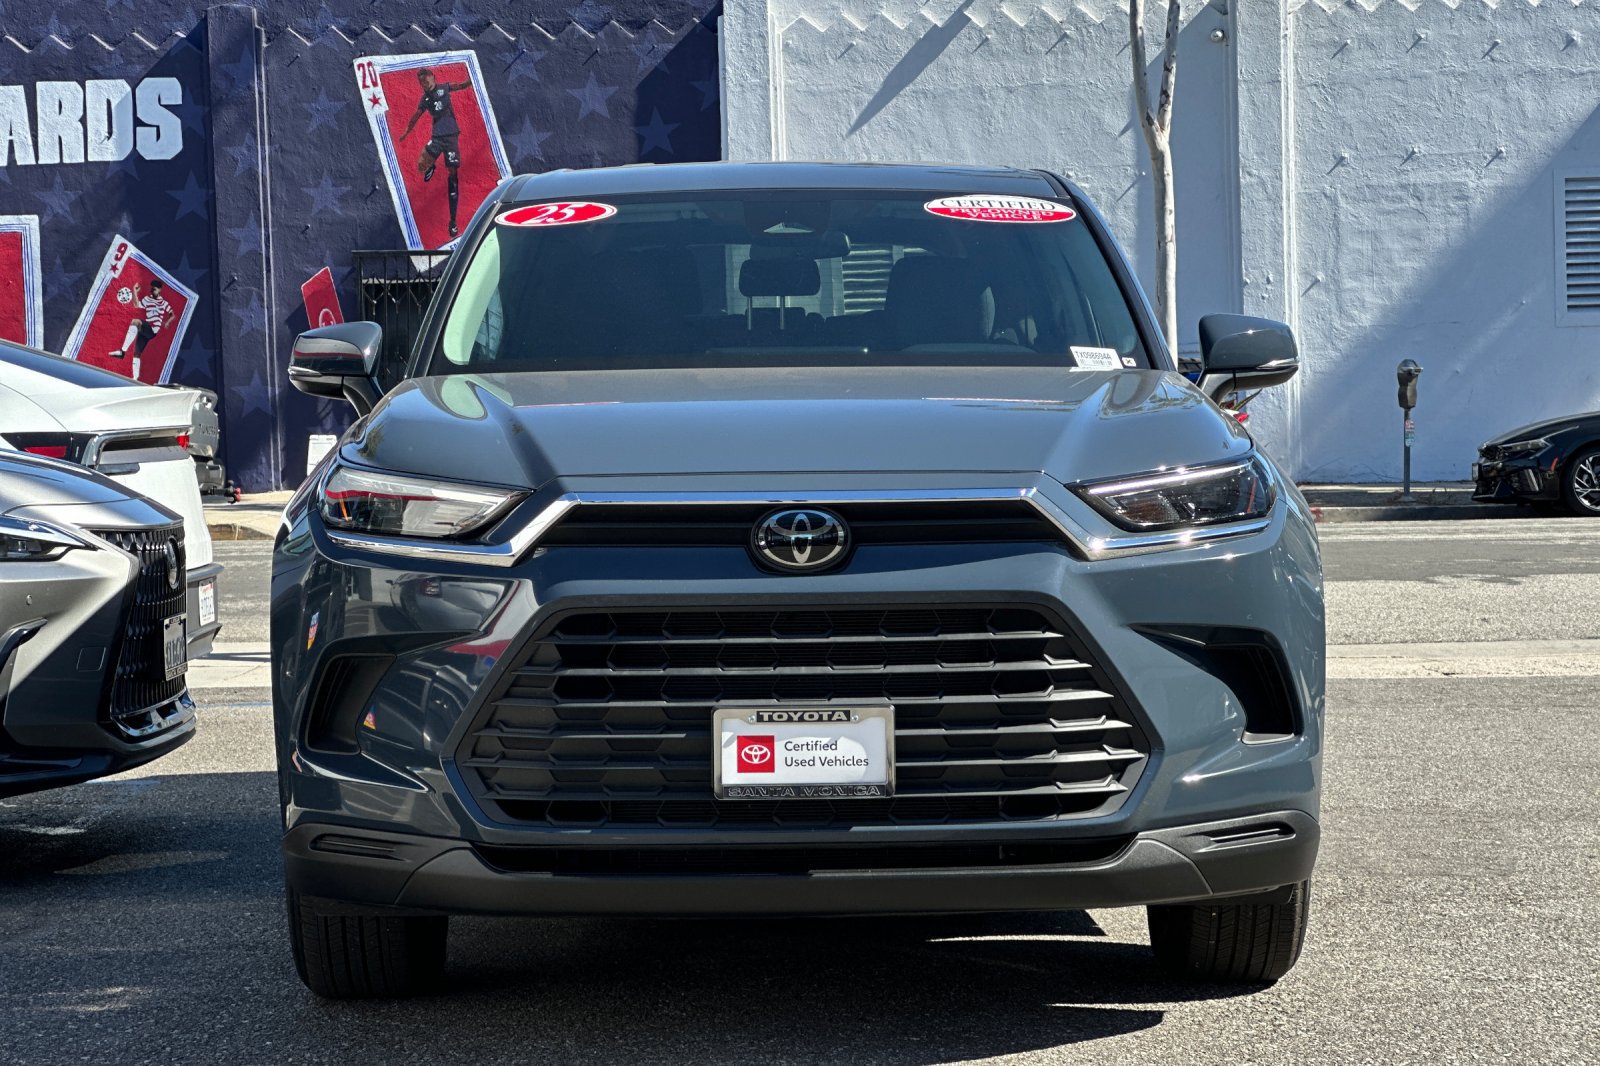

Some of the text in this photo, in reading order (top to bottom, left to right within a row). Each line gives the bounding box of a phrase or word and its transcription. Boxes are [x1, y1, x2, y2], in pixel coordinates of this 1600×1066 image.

[357, 61, 379, 89] 20
[0, 77, 183, 167] ARDS
[940, 199, 1056, 211] CERTIFIED
[520, 203, 588, 225] 25
[950, 207, 1055, 217] PRE-OWNED
[967, 212, 1043, 221] VEHICLE
[114, 242, 128, 262] 9
[759, 711, 848, 722] TOYOTA
[784, 740, 838, 752] Certified
[784, 756, 869, 767] Used Vehicles
[728, 786, 796, 797] SANTA
